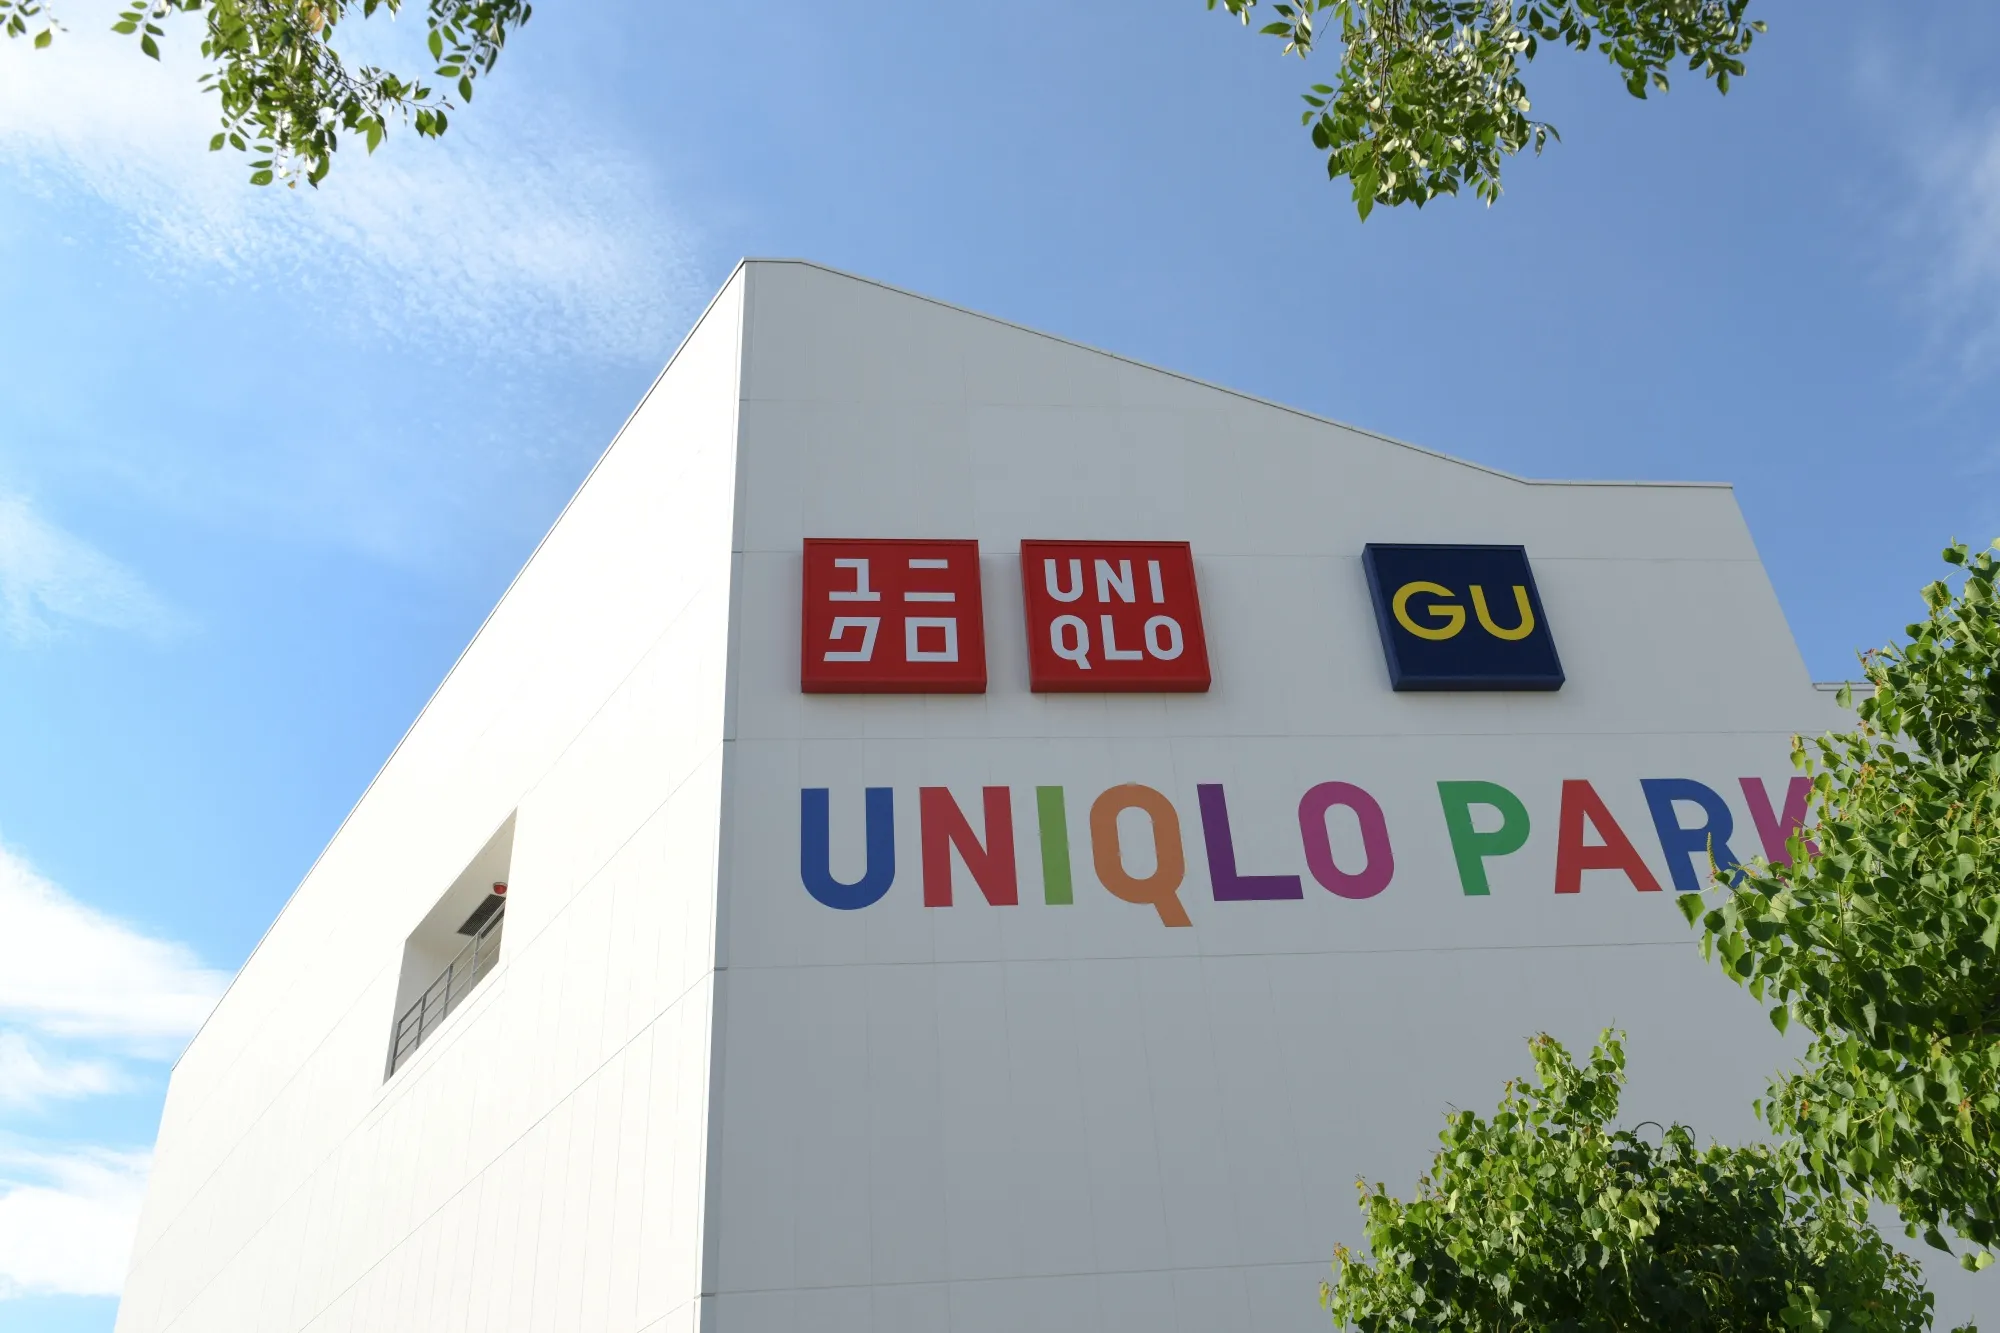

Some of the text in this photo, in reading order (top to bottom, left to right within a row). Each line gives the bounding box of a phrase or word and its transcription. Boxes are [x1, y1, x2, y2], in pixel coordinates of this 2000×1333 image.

[828, 558, 956, 603] ユニ
[1043, 558, 1166, 604] UNI
[1391, 580, 1536, 642] GU
[823, 616, 959, 663] クロ
[1049, 614, 1185, 670] QLO
[800, 779, 1395, 927] UNIQLO
